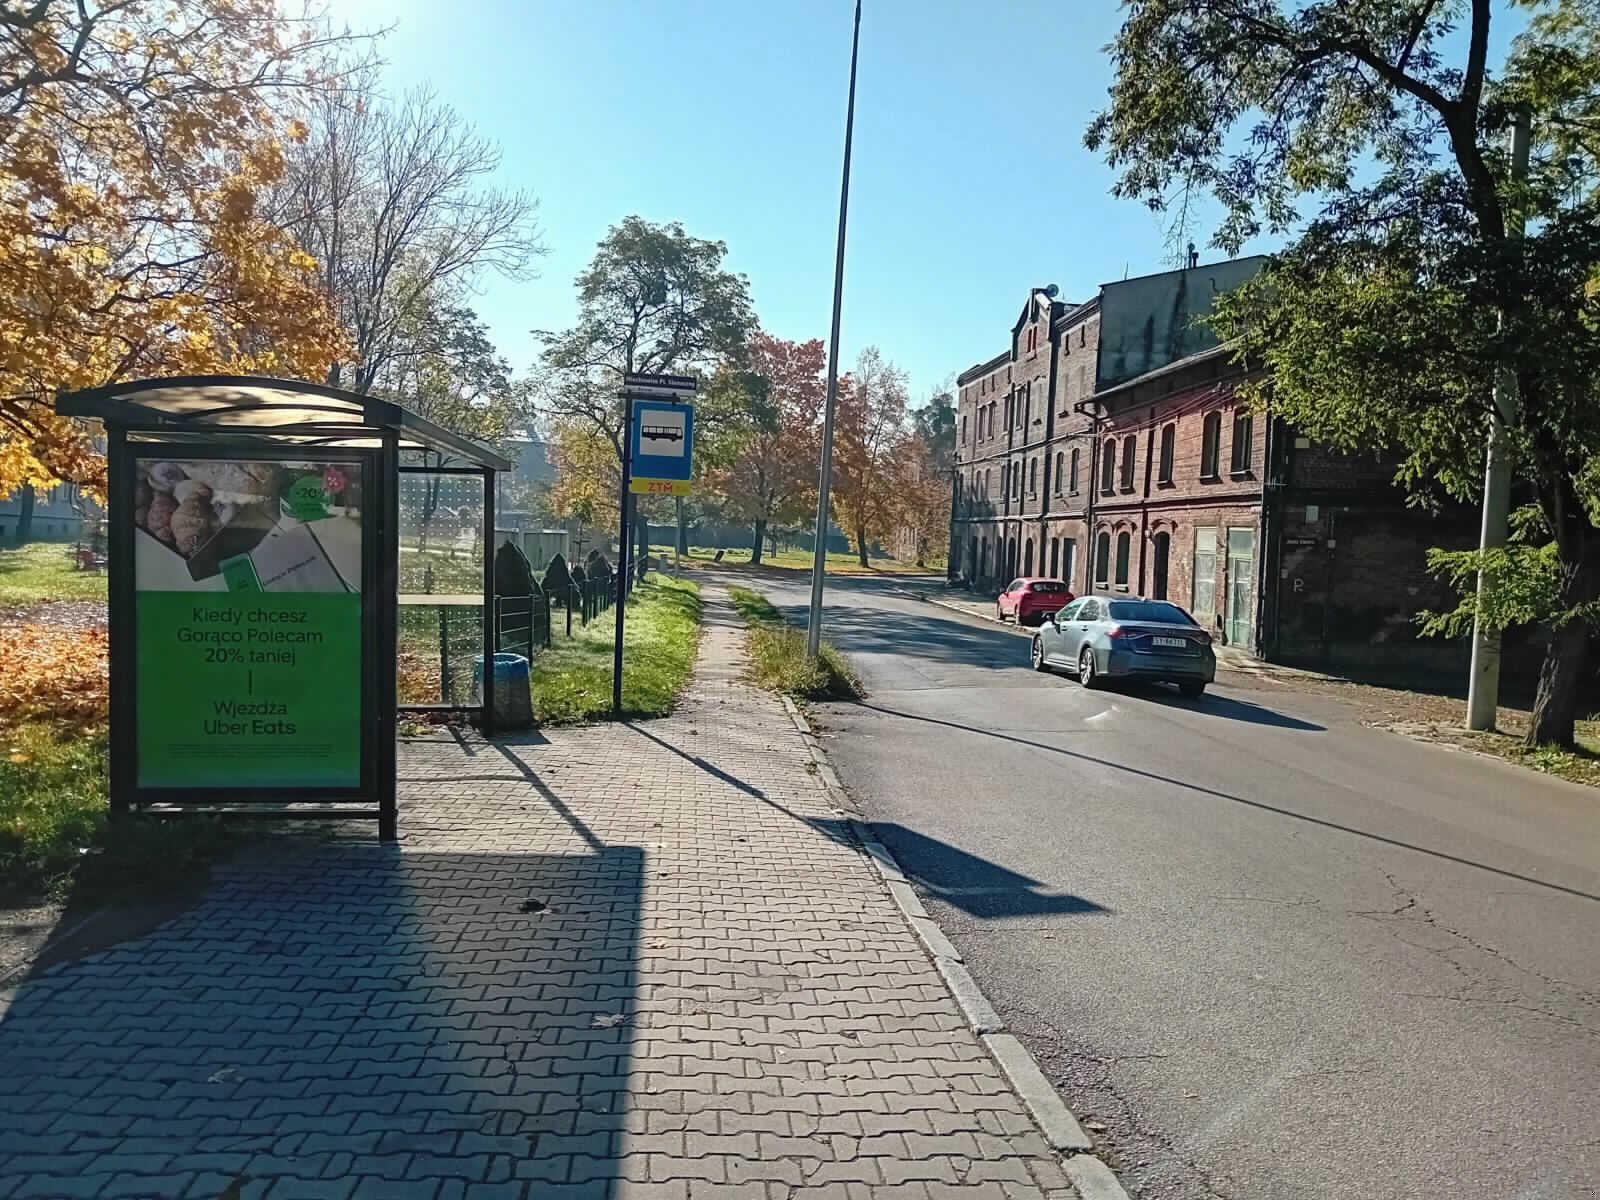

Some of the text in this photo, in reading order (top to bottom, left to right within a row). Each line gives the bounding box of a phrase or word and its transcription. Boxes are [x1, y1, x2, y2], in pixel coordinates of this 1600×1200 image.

[648, 481, 673, 492] ZTM
[192, 607, 308, 625] Kiedy chcesz
[177, 627, 323, 646] Gorąco Polecam
[205, 648, 296, 667] 20% taniej
[203, 719, 297, 736] Uber Eats
